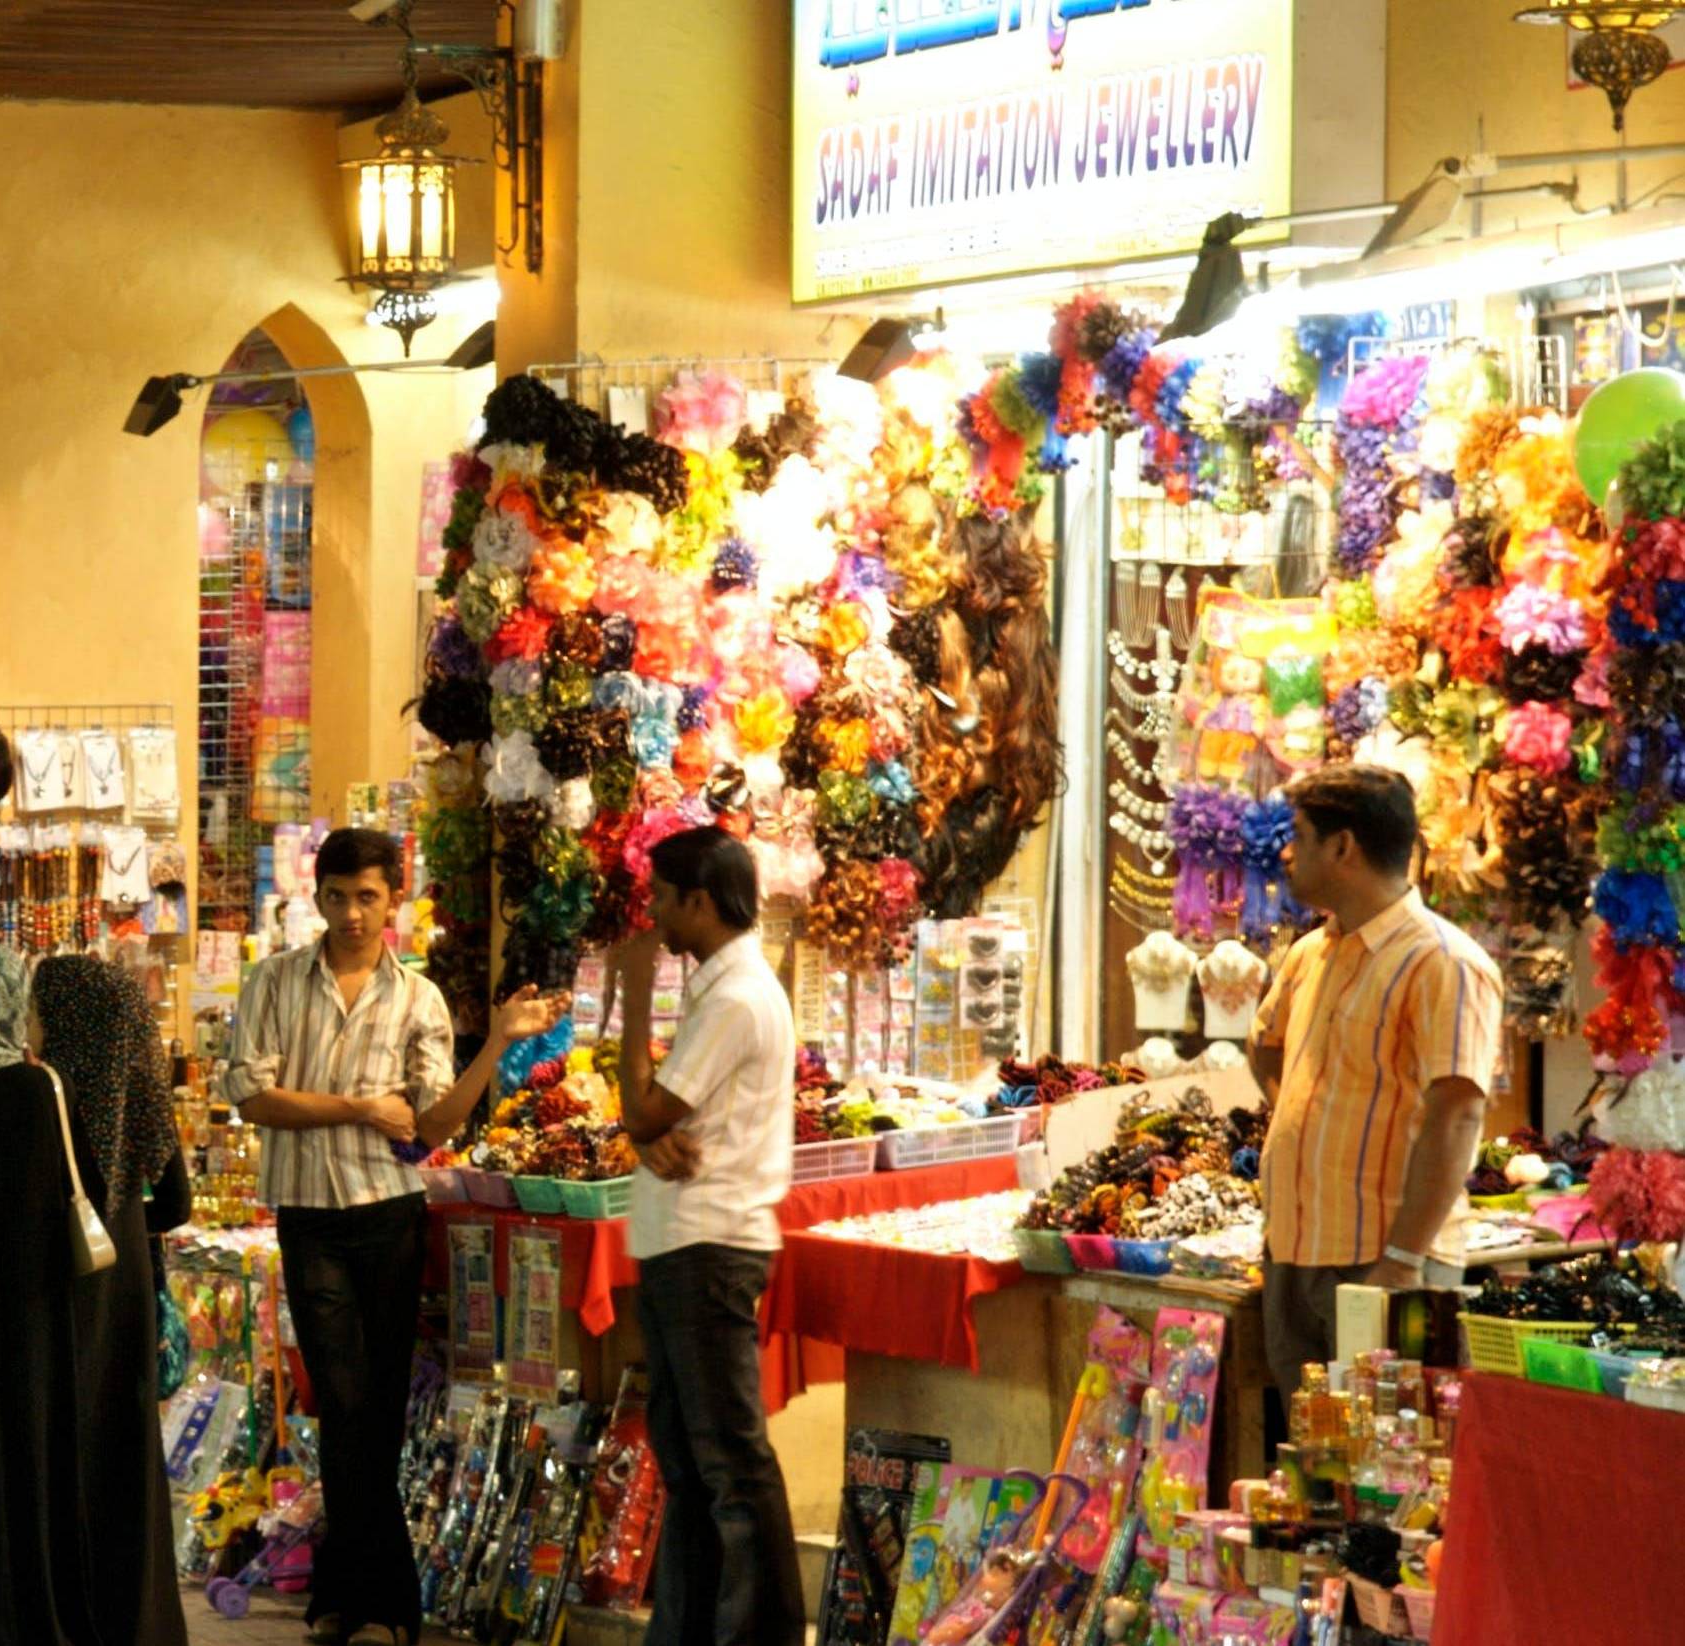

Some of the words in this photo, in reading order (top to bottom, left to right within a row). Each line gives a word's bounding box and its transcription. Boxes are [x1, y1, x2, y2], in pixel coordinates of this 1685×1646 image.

[816, 123, 899, 225] SADAF
[911, 93, 1063, 208] IMITATION
[1075, 62, 1262, 183] JEWELLERY
